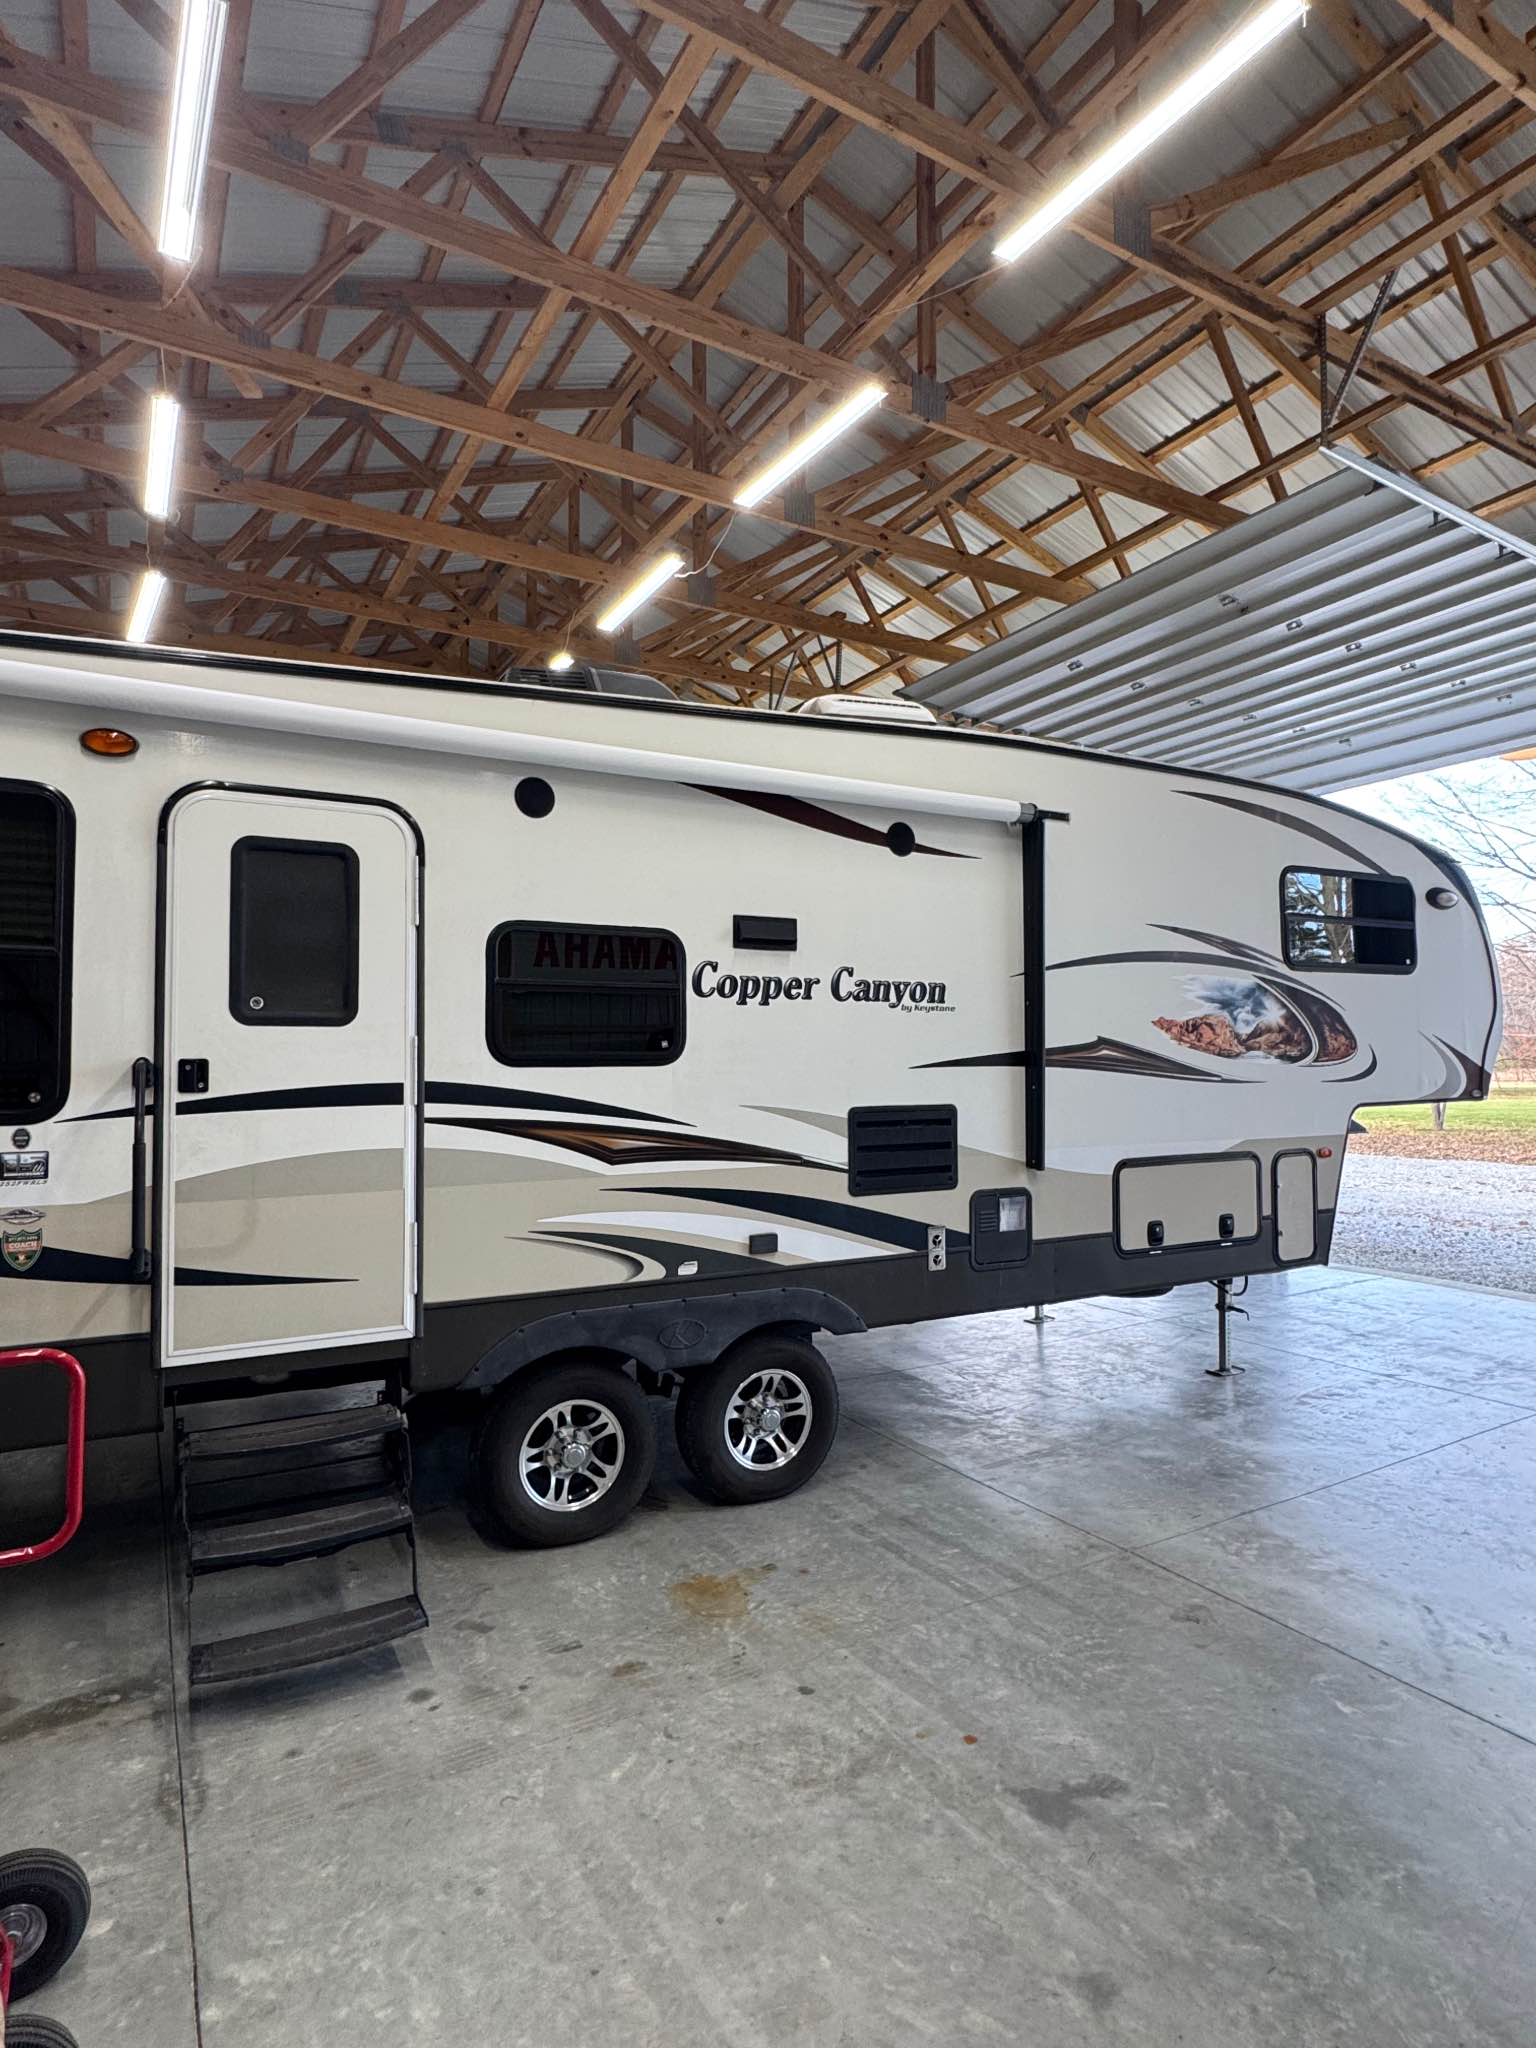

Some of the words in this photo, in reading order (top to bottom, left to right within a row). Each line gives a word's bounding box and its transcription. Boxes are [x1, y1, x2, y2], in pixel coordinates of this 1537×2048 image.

[692, 960, 820, 1006] Copper
[830, 966, 946, 1008] Canyon
[901, 1003, 912, 1013] by
[914, 1004, 956, 1013] Keystone
